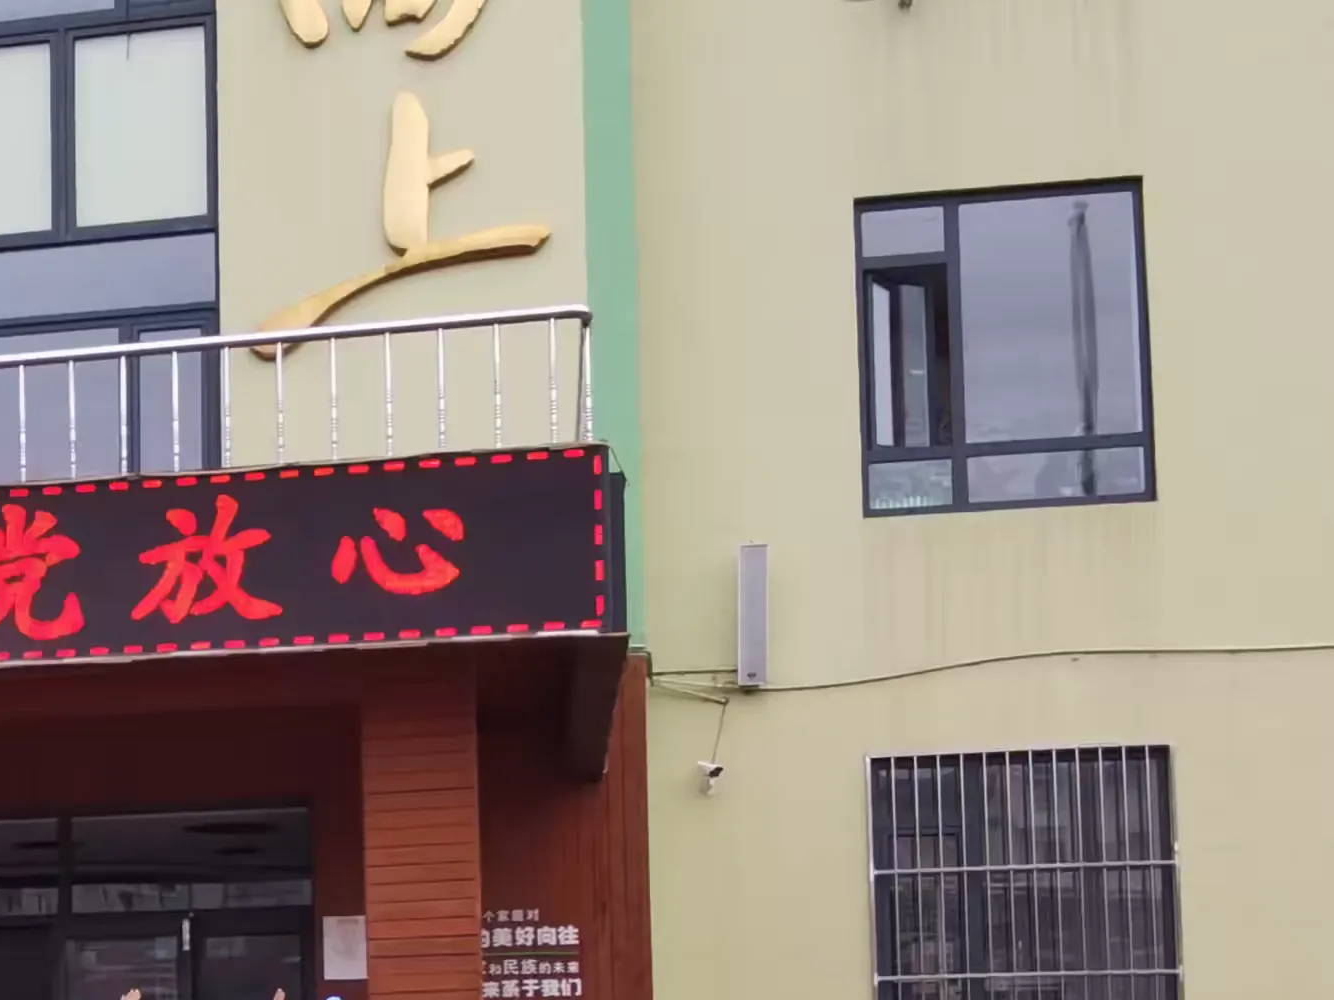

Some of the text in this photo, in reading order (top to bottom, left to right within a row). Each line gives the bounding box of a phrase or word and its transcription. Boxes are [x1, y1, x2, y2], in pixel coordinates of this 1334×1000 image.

[482, 959, 580, 976] 和民族的未
